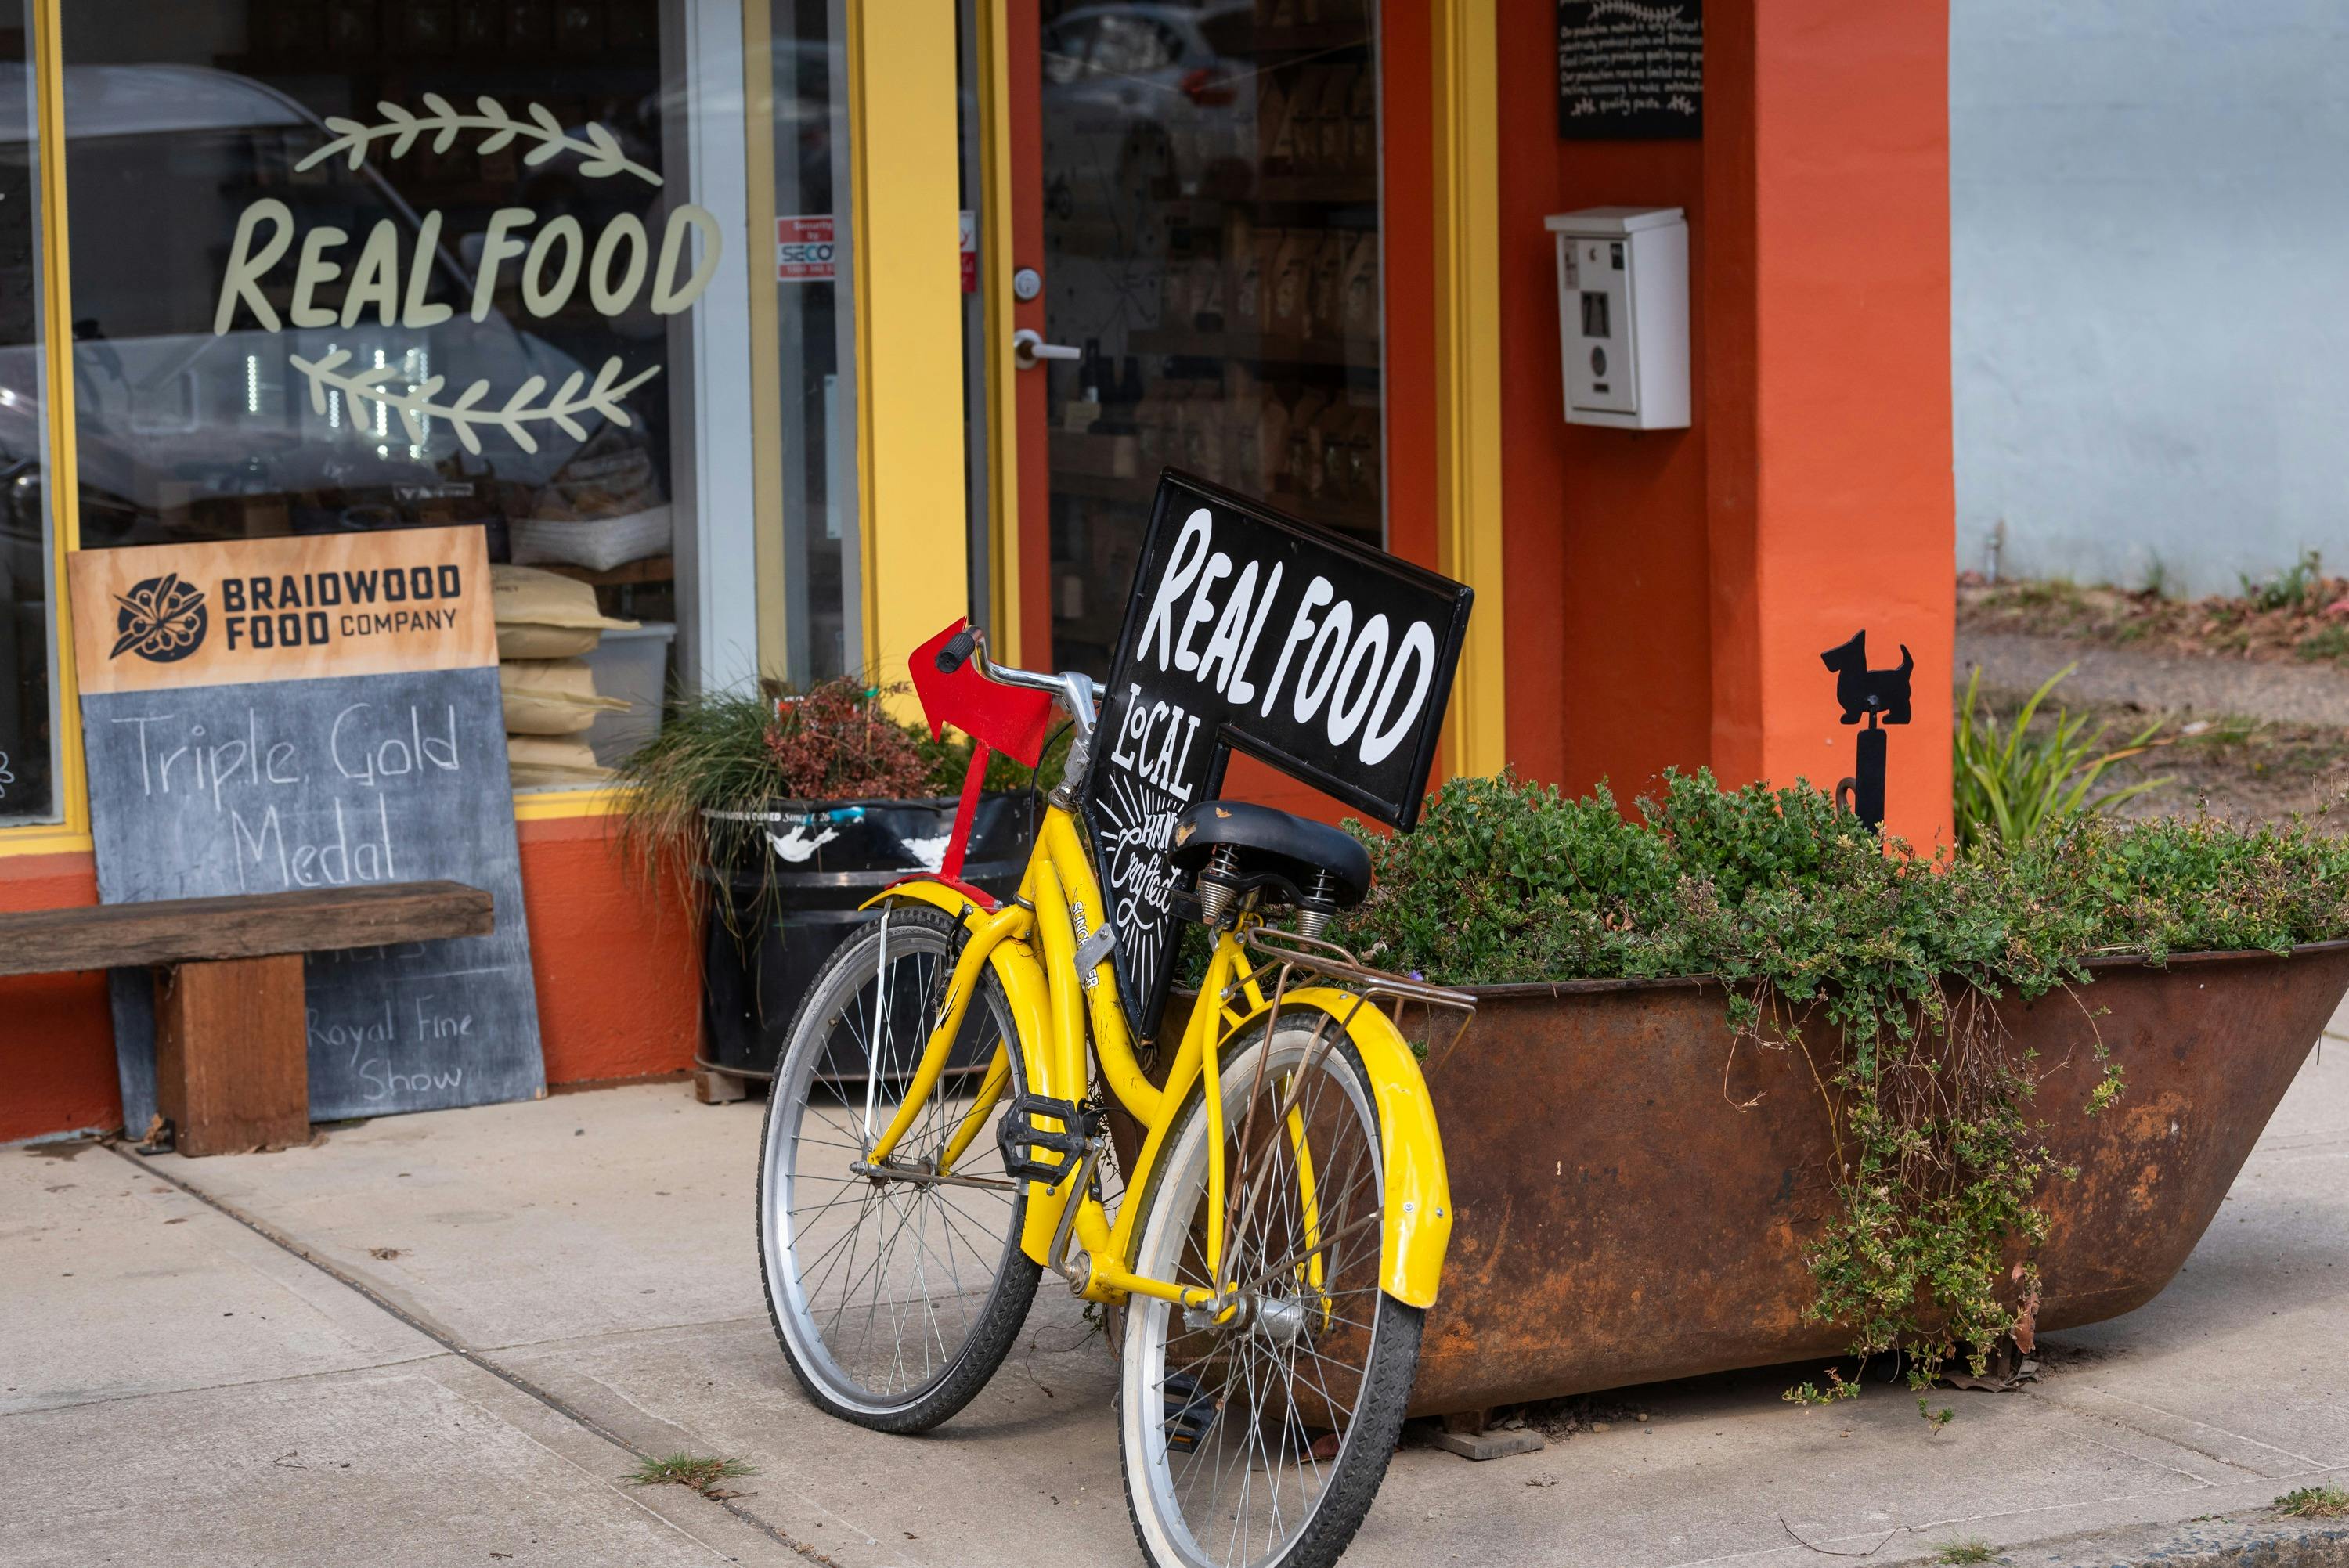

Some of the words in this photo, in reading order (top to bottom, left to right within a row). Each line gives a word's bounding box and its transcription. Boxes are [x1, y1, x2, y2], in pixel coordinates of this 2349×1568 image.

[213, 197, 453, 337] REAL
[471, 203, 723, 323] FOOD
[782, 244, 835, 262] SECO
[222, 564, 461, 613] BRAIDWOOD
[226, 611, 330, 651] FOOD
[341, 607, 456, 636] COMPANY
[1137, 507, 1283, 705] REAL
[1261, 575, 1436, 766] FOOD
[110, 706, 301, 813] Triple
[330, 702, 460, 787] Gold
[232, 791, 394, 891] Medal
[1139, 809, 1179, 853] HAN
[1110, 827, 1182, 930] Crafted
[305, 999, 395, 1068] Royal
[416, 993, 473, 1041] Fine
[359, 1058, 463, 1101] Show
